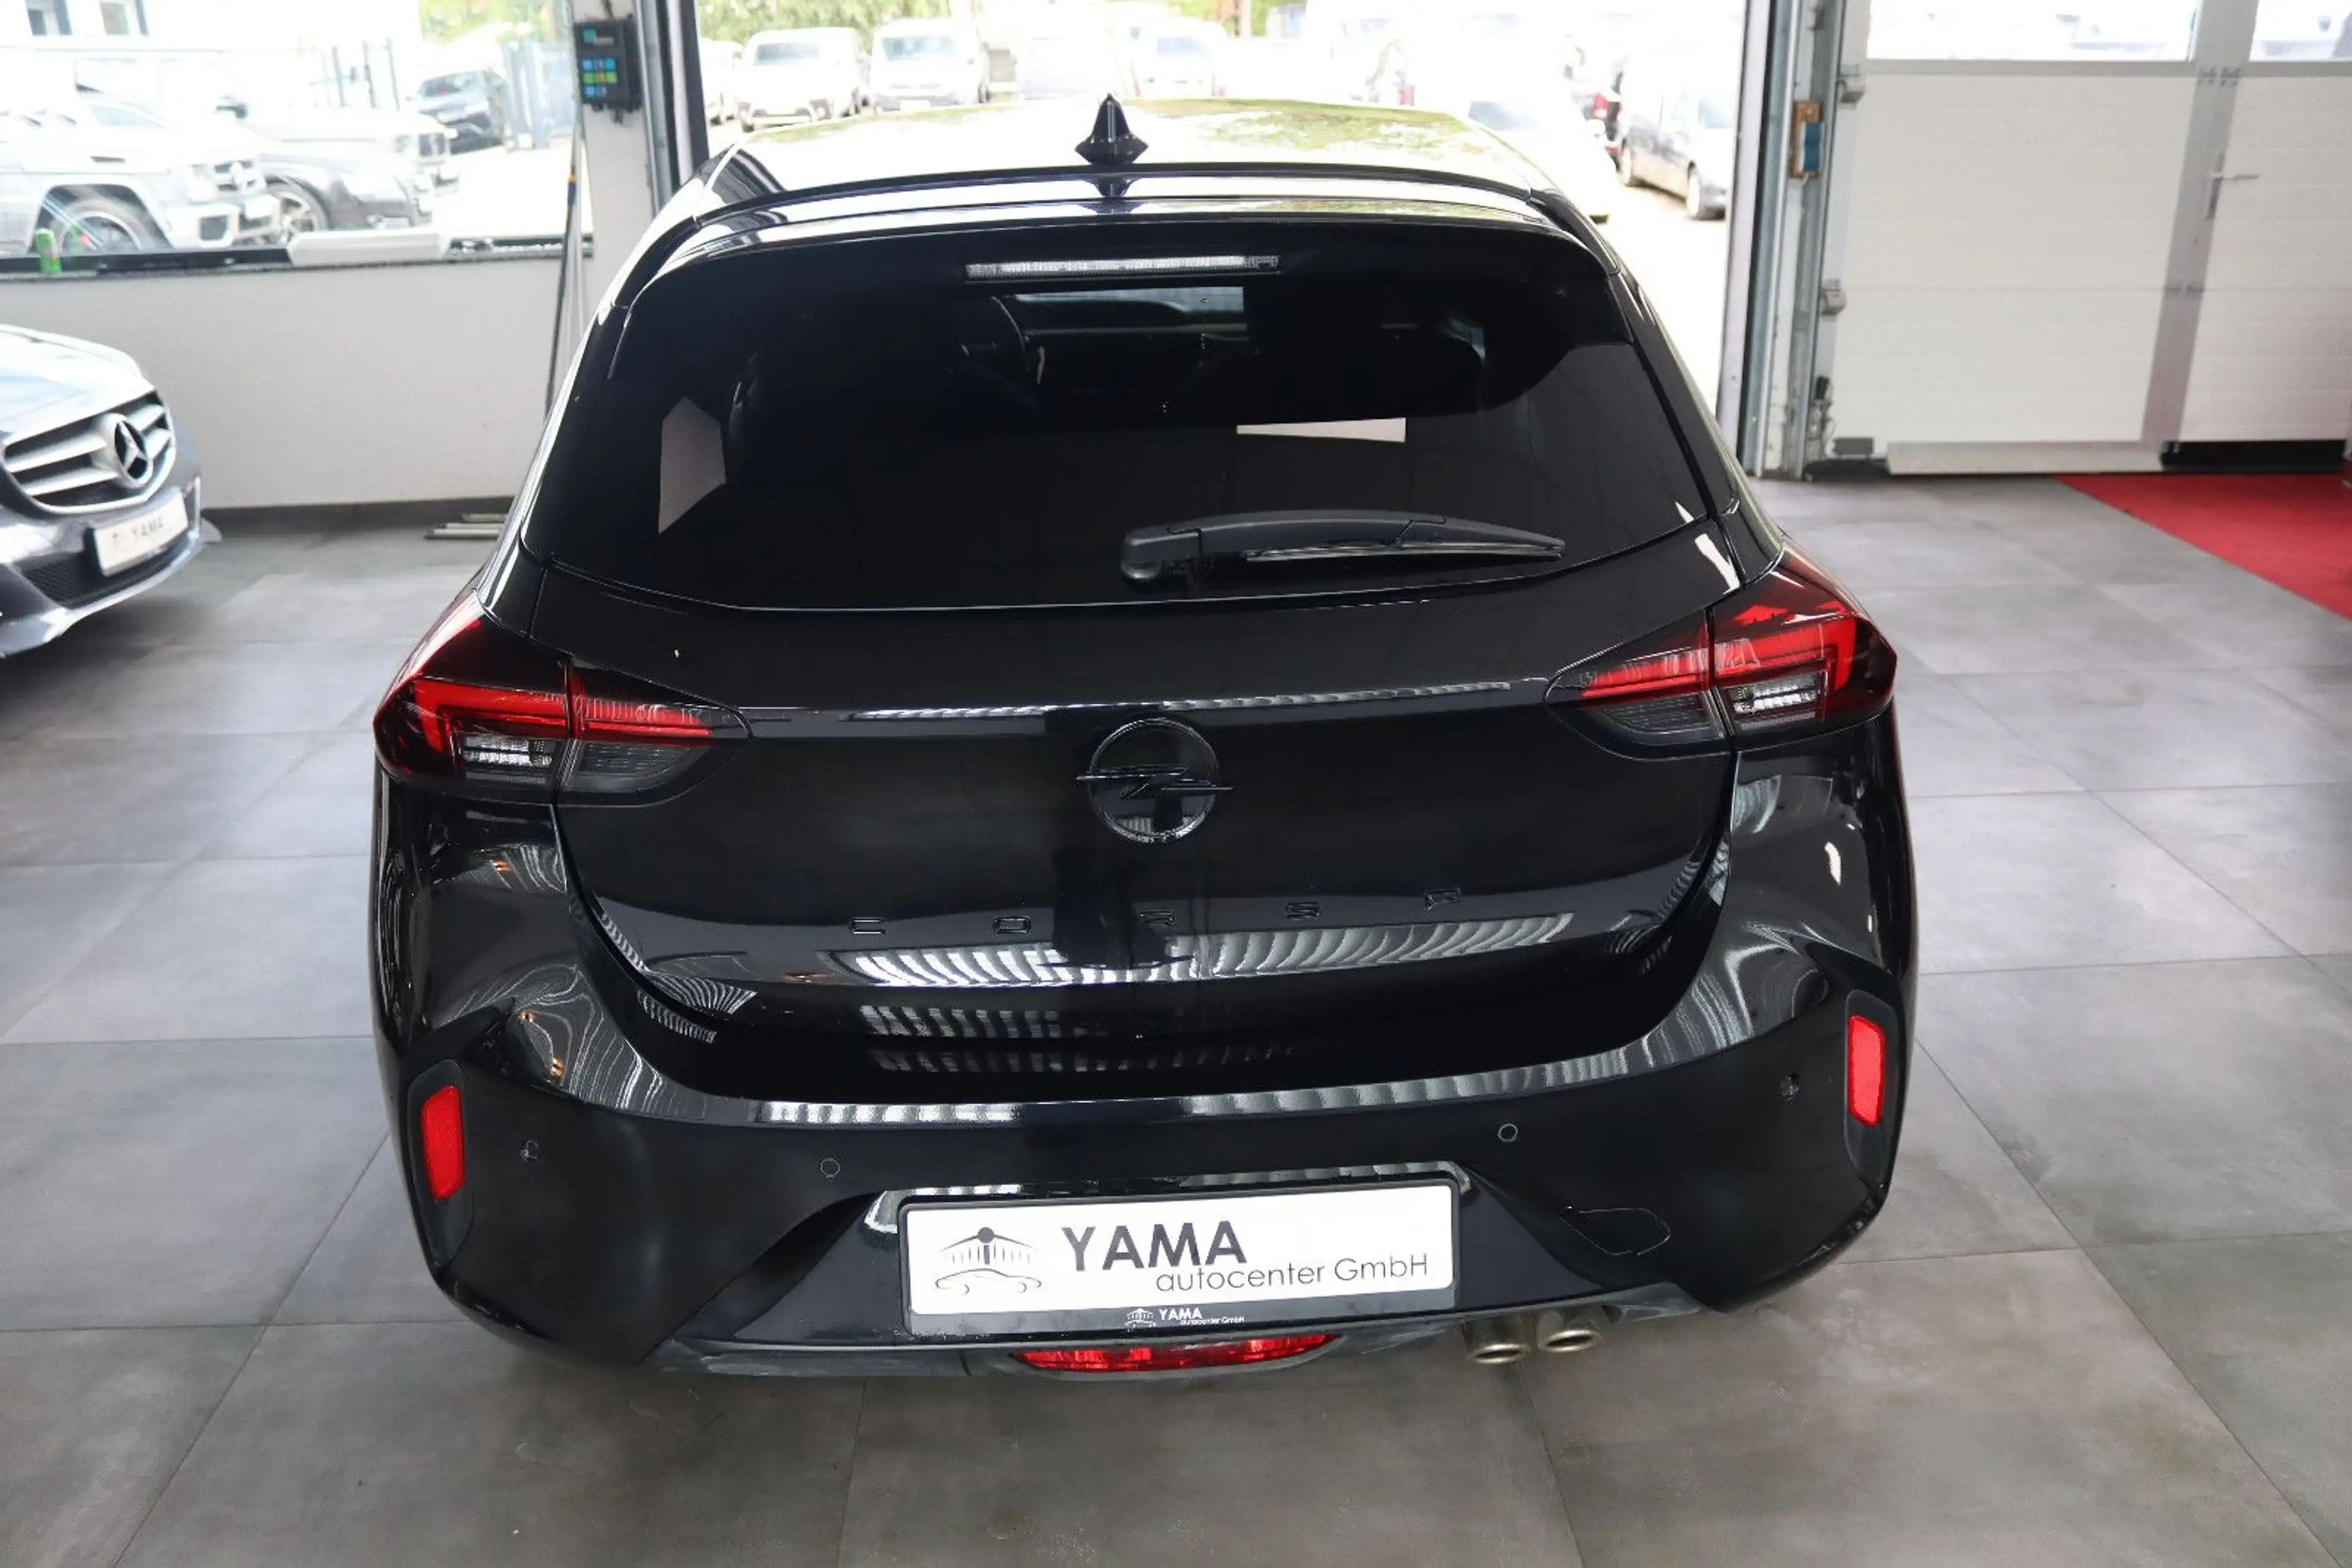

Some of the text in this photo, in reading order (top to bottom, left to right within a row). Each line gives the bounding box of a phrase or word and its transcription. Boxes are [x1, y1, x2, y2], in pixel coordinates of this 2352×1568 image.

[1061, 1220, 1247, 1272] YAMA
[1156, 1253, 1428, 1292] autocenter GmbH
[1158, 1308, 1203, 1321] YAMA
